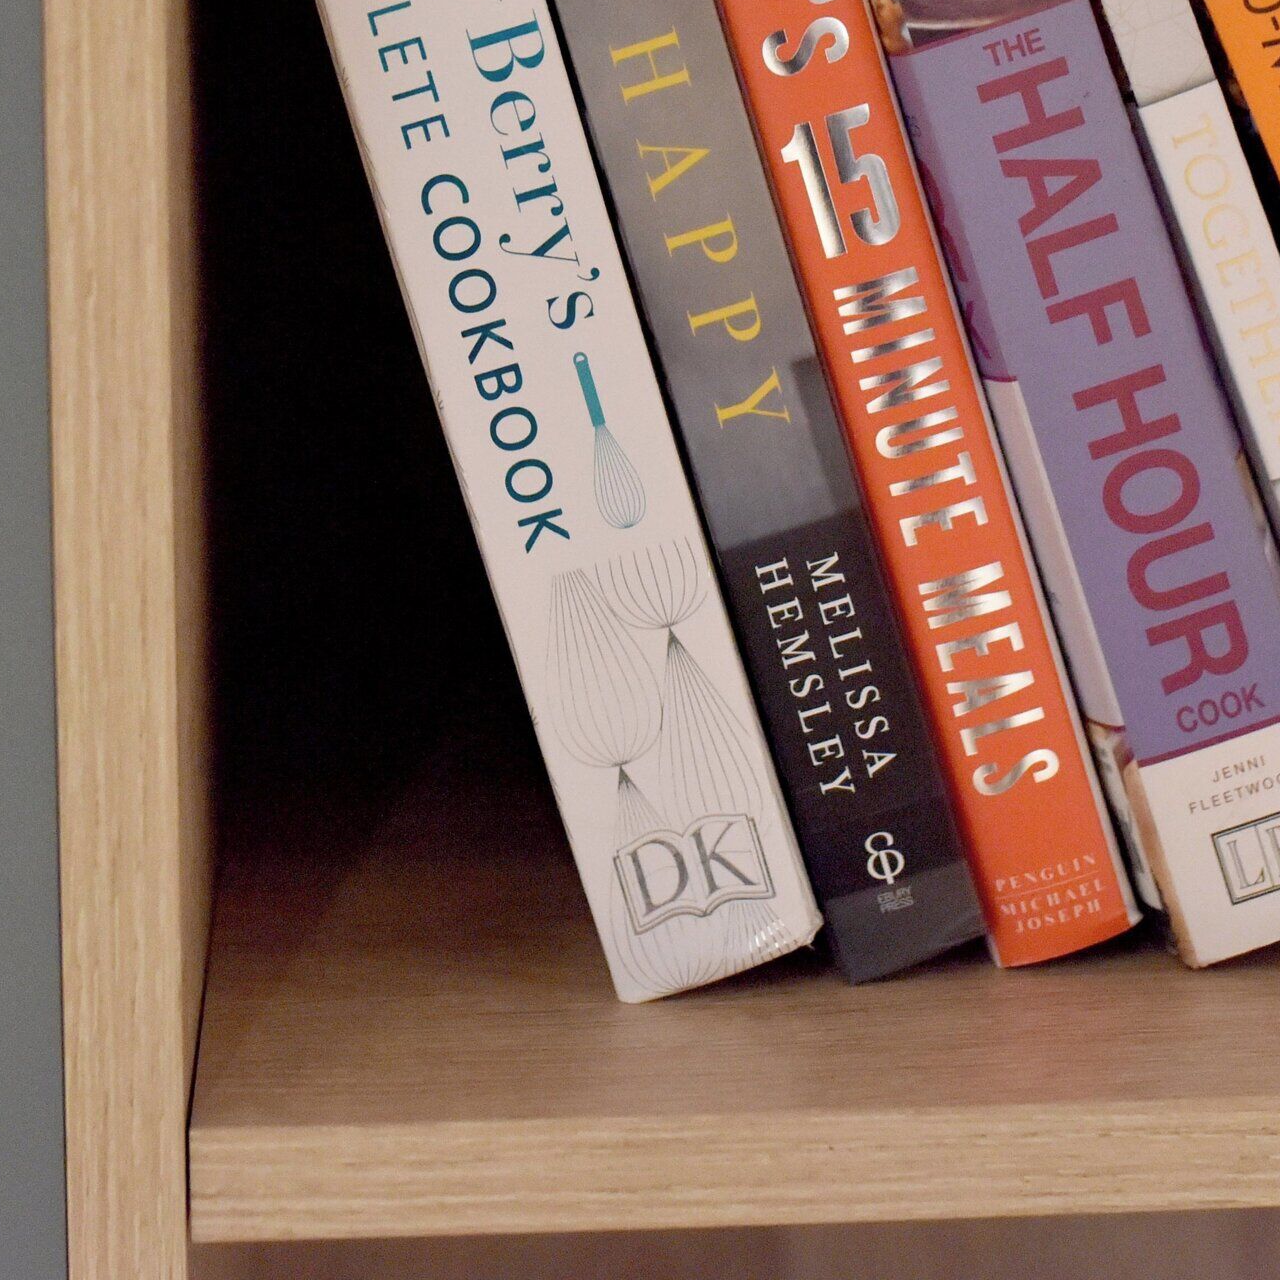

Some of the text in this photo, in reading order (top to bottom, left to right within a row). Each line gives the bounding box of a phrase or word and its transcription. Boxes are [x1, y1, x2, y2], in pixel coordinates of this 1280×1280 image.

[983, 28, 1045, 67] THE
[465, 11, 600, 331] Berry's
[609, 26, 790, 430] HAPPY
[781, 103, 901, 259] 15
[420, 173, 570, 553] COOKBOOK
[833, 266, 988, 548] MINUTE
[976, 56, 1251, 696] HALF HOUR
[754, 556, 856, 798] HEMSLEY
[807, 551, 899, 778] MELISSA
[917, 560, 1063, 798] MEALS
[1175, 684, 1265, 734] COOK
[1212, 754, 1267, 784] JENNI
[628, 817, 757, 913] DK
[994, 853, 1099, 893] PENGUIN
[999, 880, 1106, 918] MICHAEL
[1014, 899, 1103, 934] JOSEPH
